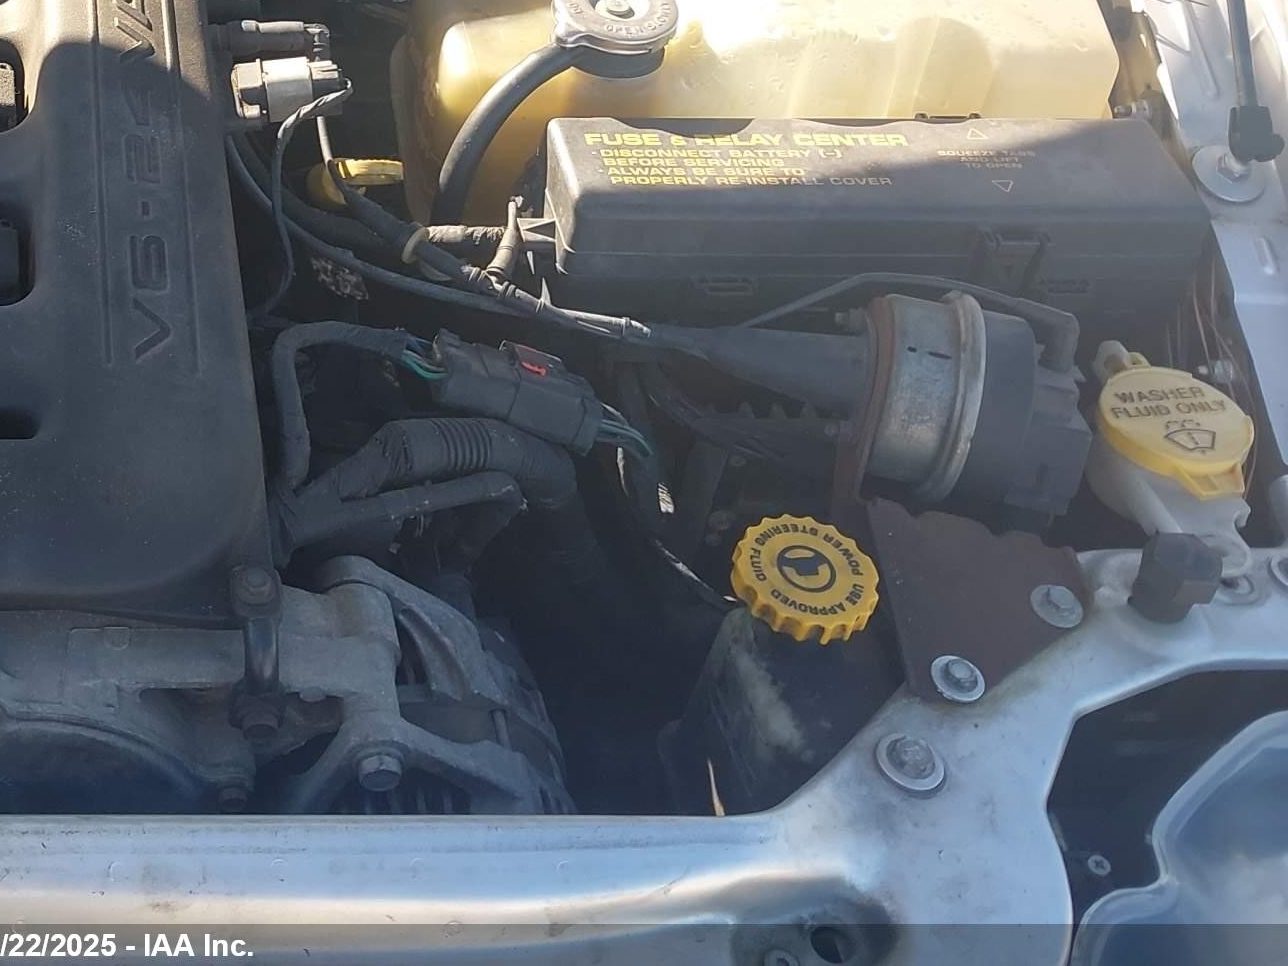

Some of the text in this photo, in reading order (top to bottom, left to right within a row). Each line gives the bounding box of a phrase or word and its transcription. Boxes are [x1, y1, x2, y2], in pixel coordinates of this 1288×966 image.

[606, 24, 646, 35] OPEN
[584, 133, 909, 147] FUSE & RELAY CENTER
[600, 148, 722, 159] DISCONNECT
[732, 148, 812, 159] BATTERY
[603, 157, 785, 168] BEFORE SERVICING
[606, 167, 806, 177] ALWAYS BE SURE TO
[611, 176, 894, 186] PROPERLY RE-INSTALL COVER
[1114, 385, 1206, 404] WASHER
[1110, 398, 1227, 419] FLUID ONLY
[749, 523, 864, 582] POWER STEERING FLUID
[770, 583, 865, 616] USE APPROVED
